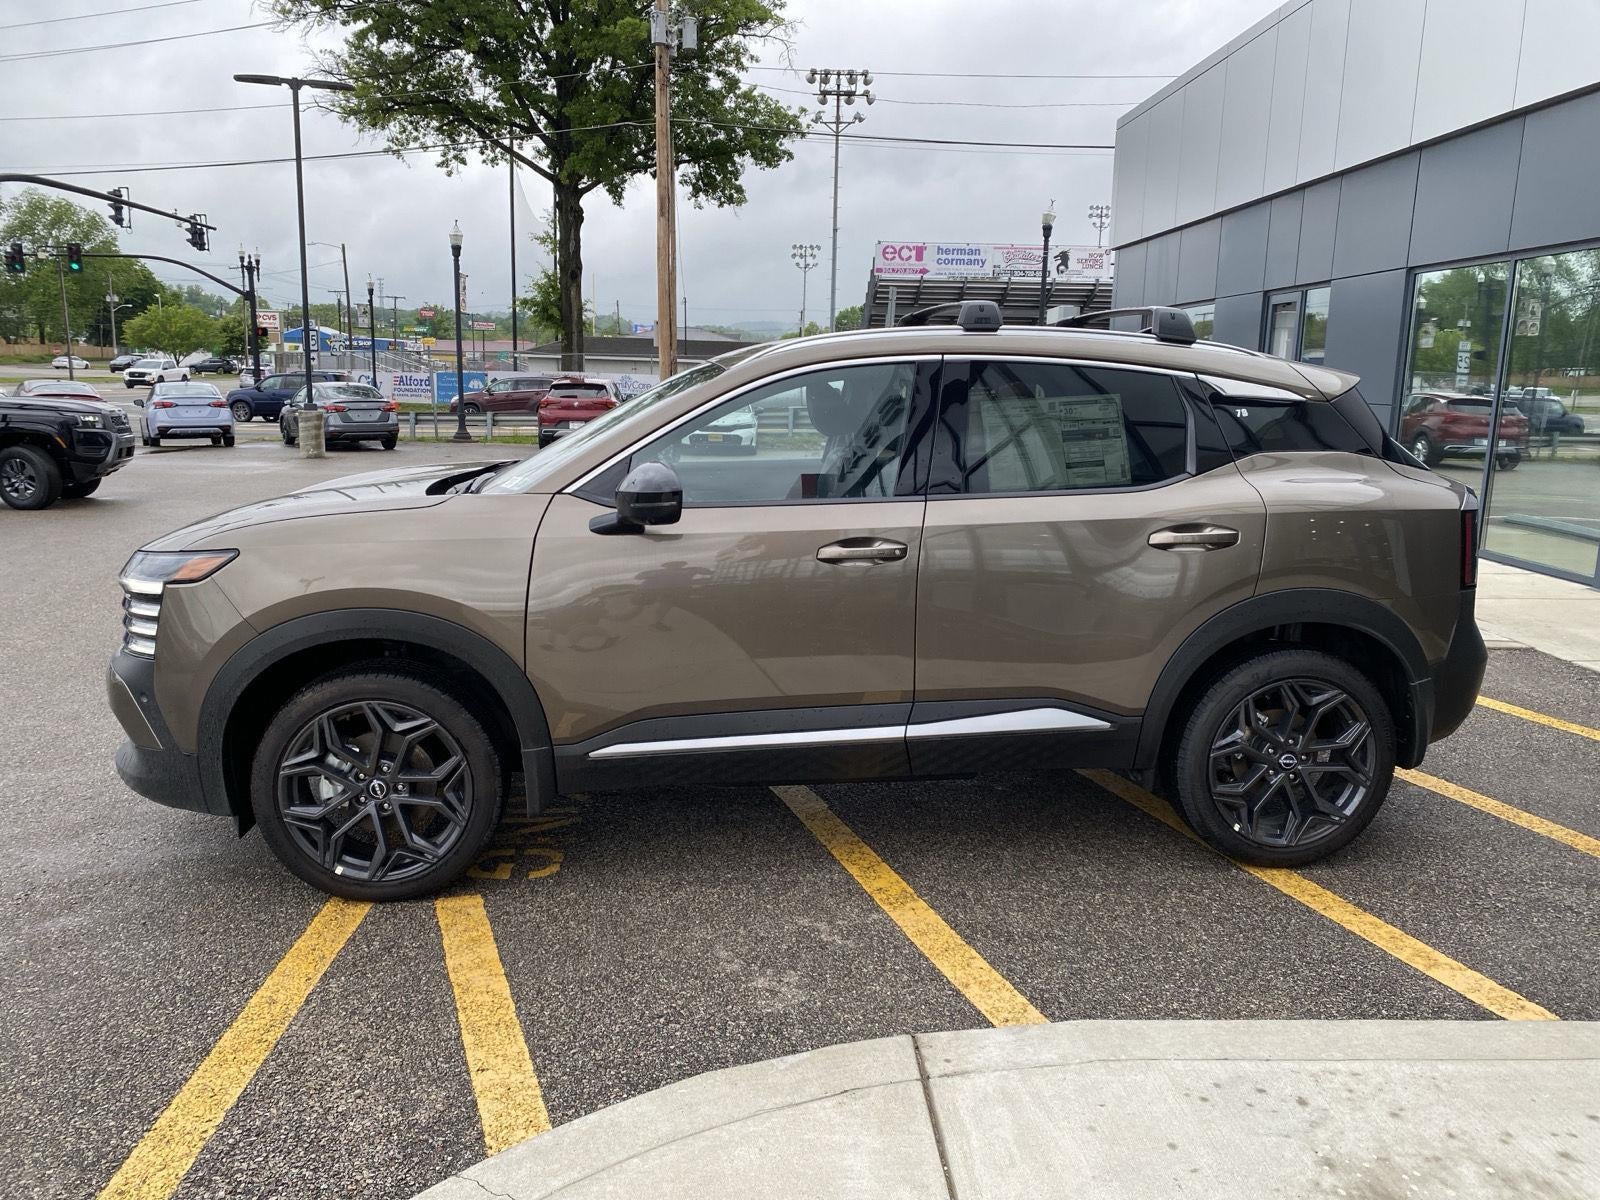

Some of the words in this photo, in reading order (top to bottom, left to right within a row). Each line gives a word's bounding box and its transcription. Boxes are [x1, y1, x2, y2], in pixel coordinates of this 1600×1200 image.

[936, 246, 981, 256] herman
[936, 257, 987, 268] cormany
[331, 344, 345, 352] 60
[399, 375, 431, 387] Alford
